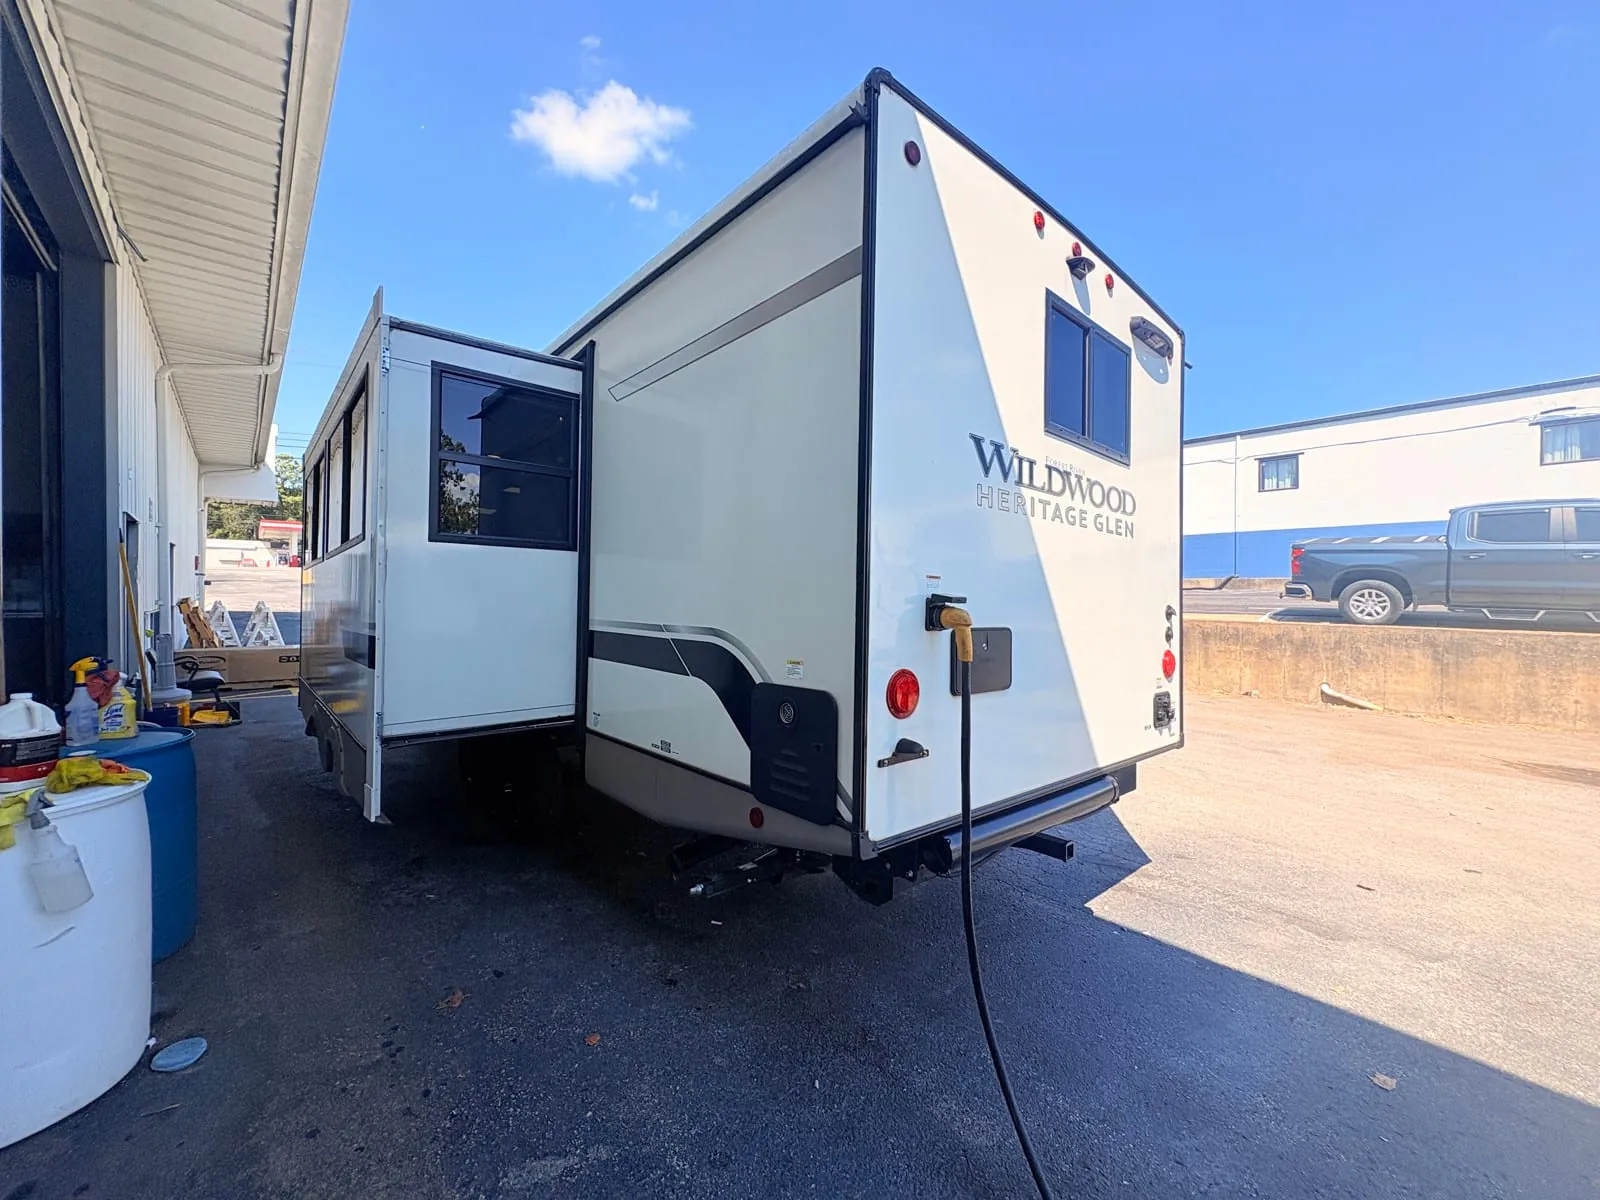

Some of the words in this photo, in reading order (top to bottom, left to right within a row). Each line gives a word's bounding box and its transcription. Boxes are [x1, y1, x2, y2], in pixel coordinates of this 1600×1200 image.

[969, 433, 1136, 516] WILDWOOD
[976, 483, 1088, 528] HERITAGE
[1094, 513, 1134, 539] GLEN
